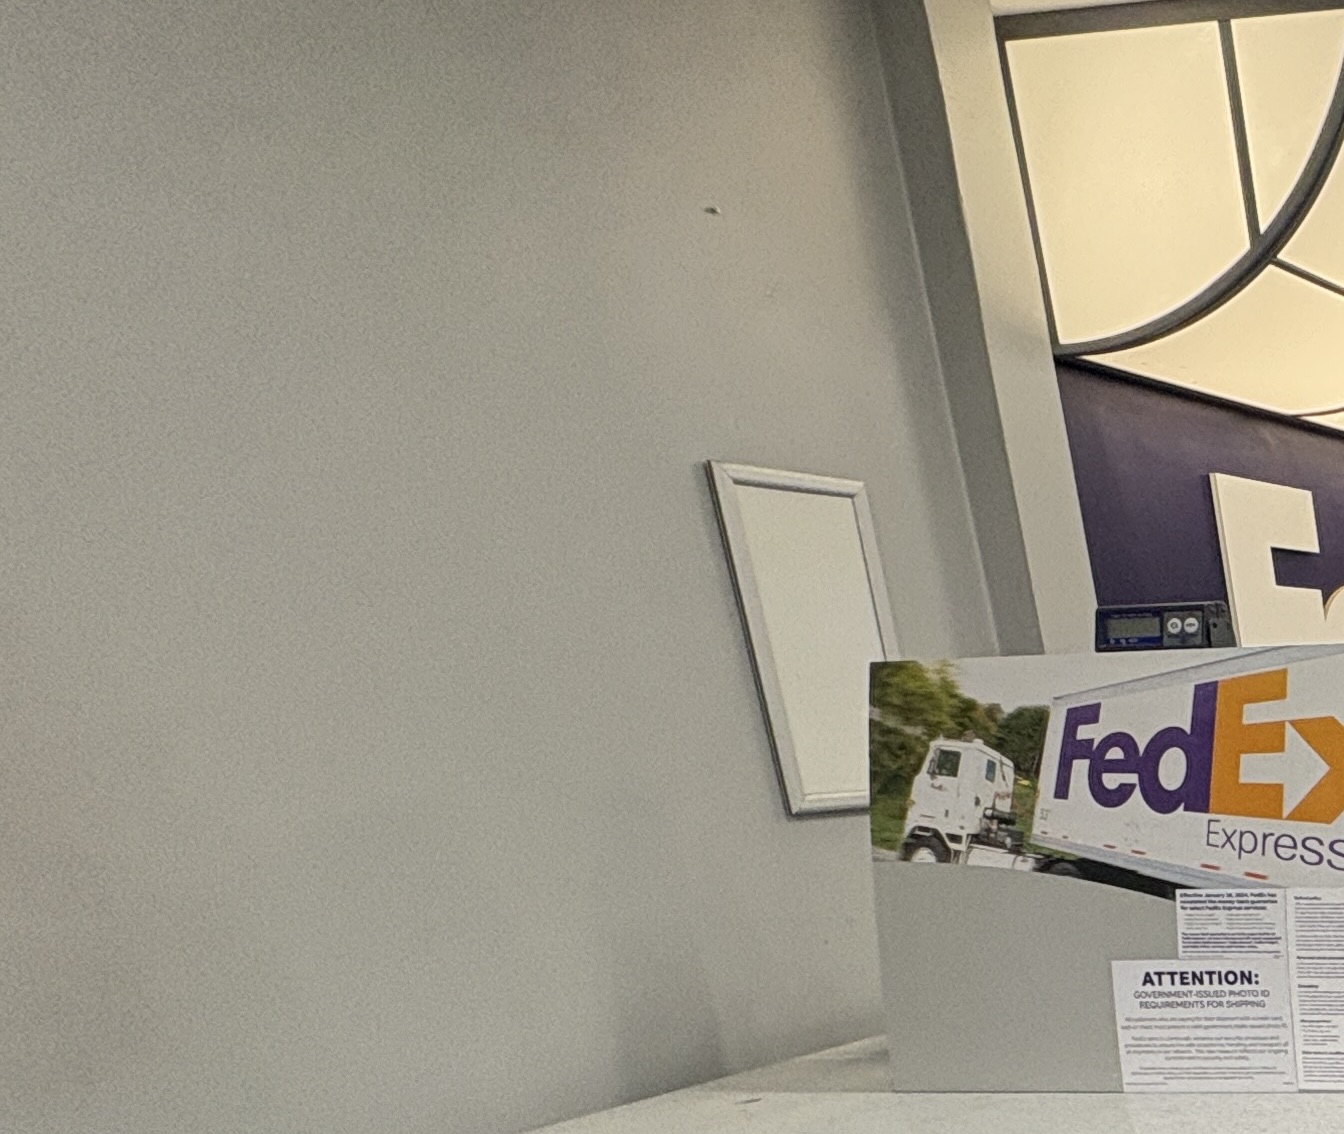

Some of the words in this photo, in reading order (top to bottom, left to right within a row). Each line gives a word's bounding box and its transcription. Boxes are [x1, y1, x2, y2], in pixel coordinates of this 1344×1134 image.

[1141, 970, 1260, 986] ATTENTION:
[1133, 990, 1227, 999] GOVERNMENT-ISSUED
[1228, 990, 1259, 998] PHOTO
[1260, 990, 1270, 998] ID
[1139, 1000, 1206, 1009] REQUIREMENTS
[1206, 1000, 1225, 1008] FOR
[1226, 1000, 1266, 1009] SHIPPING
